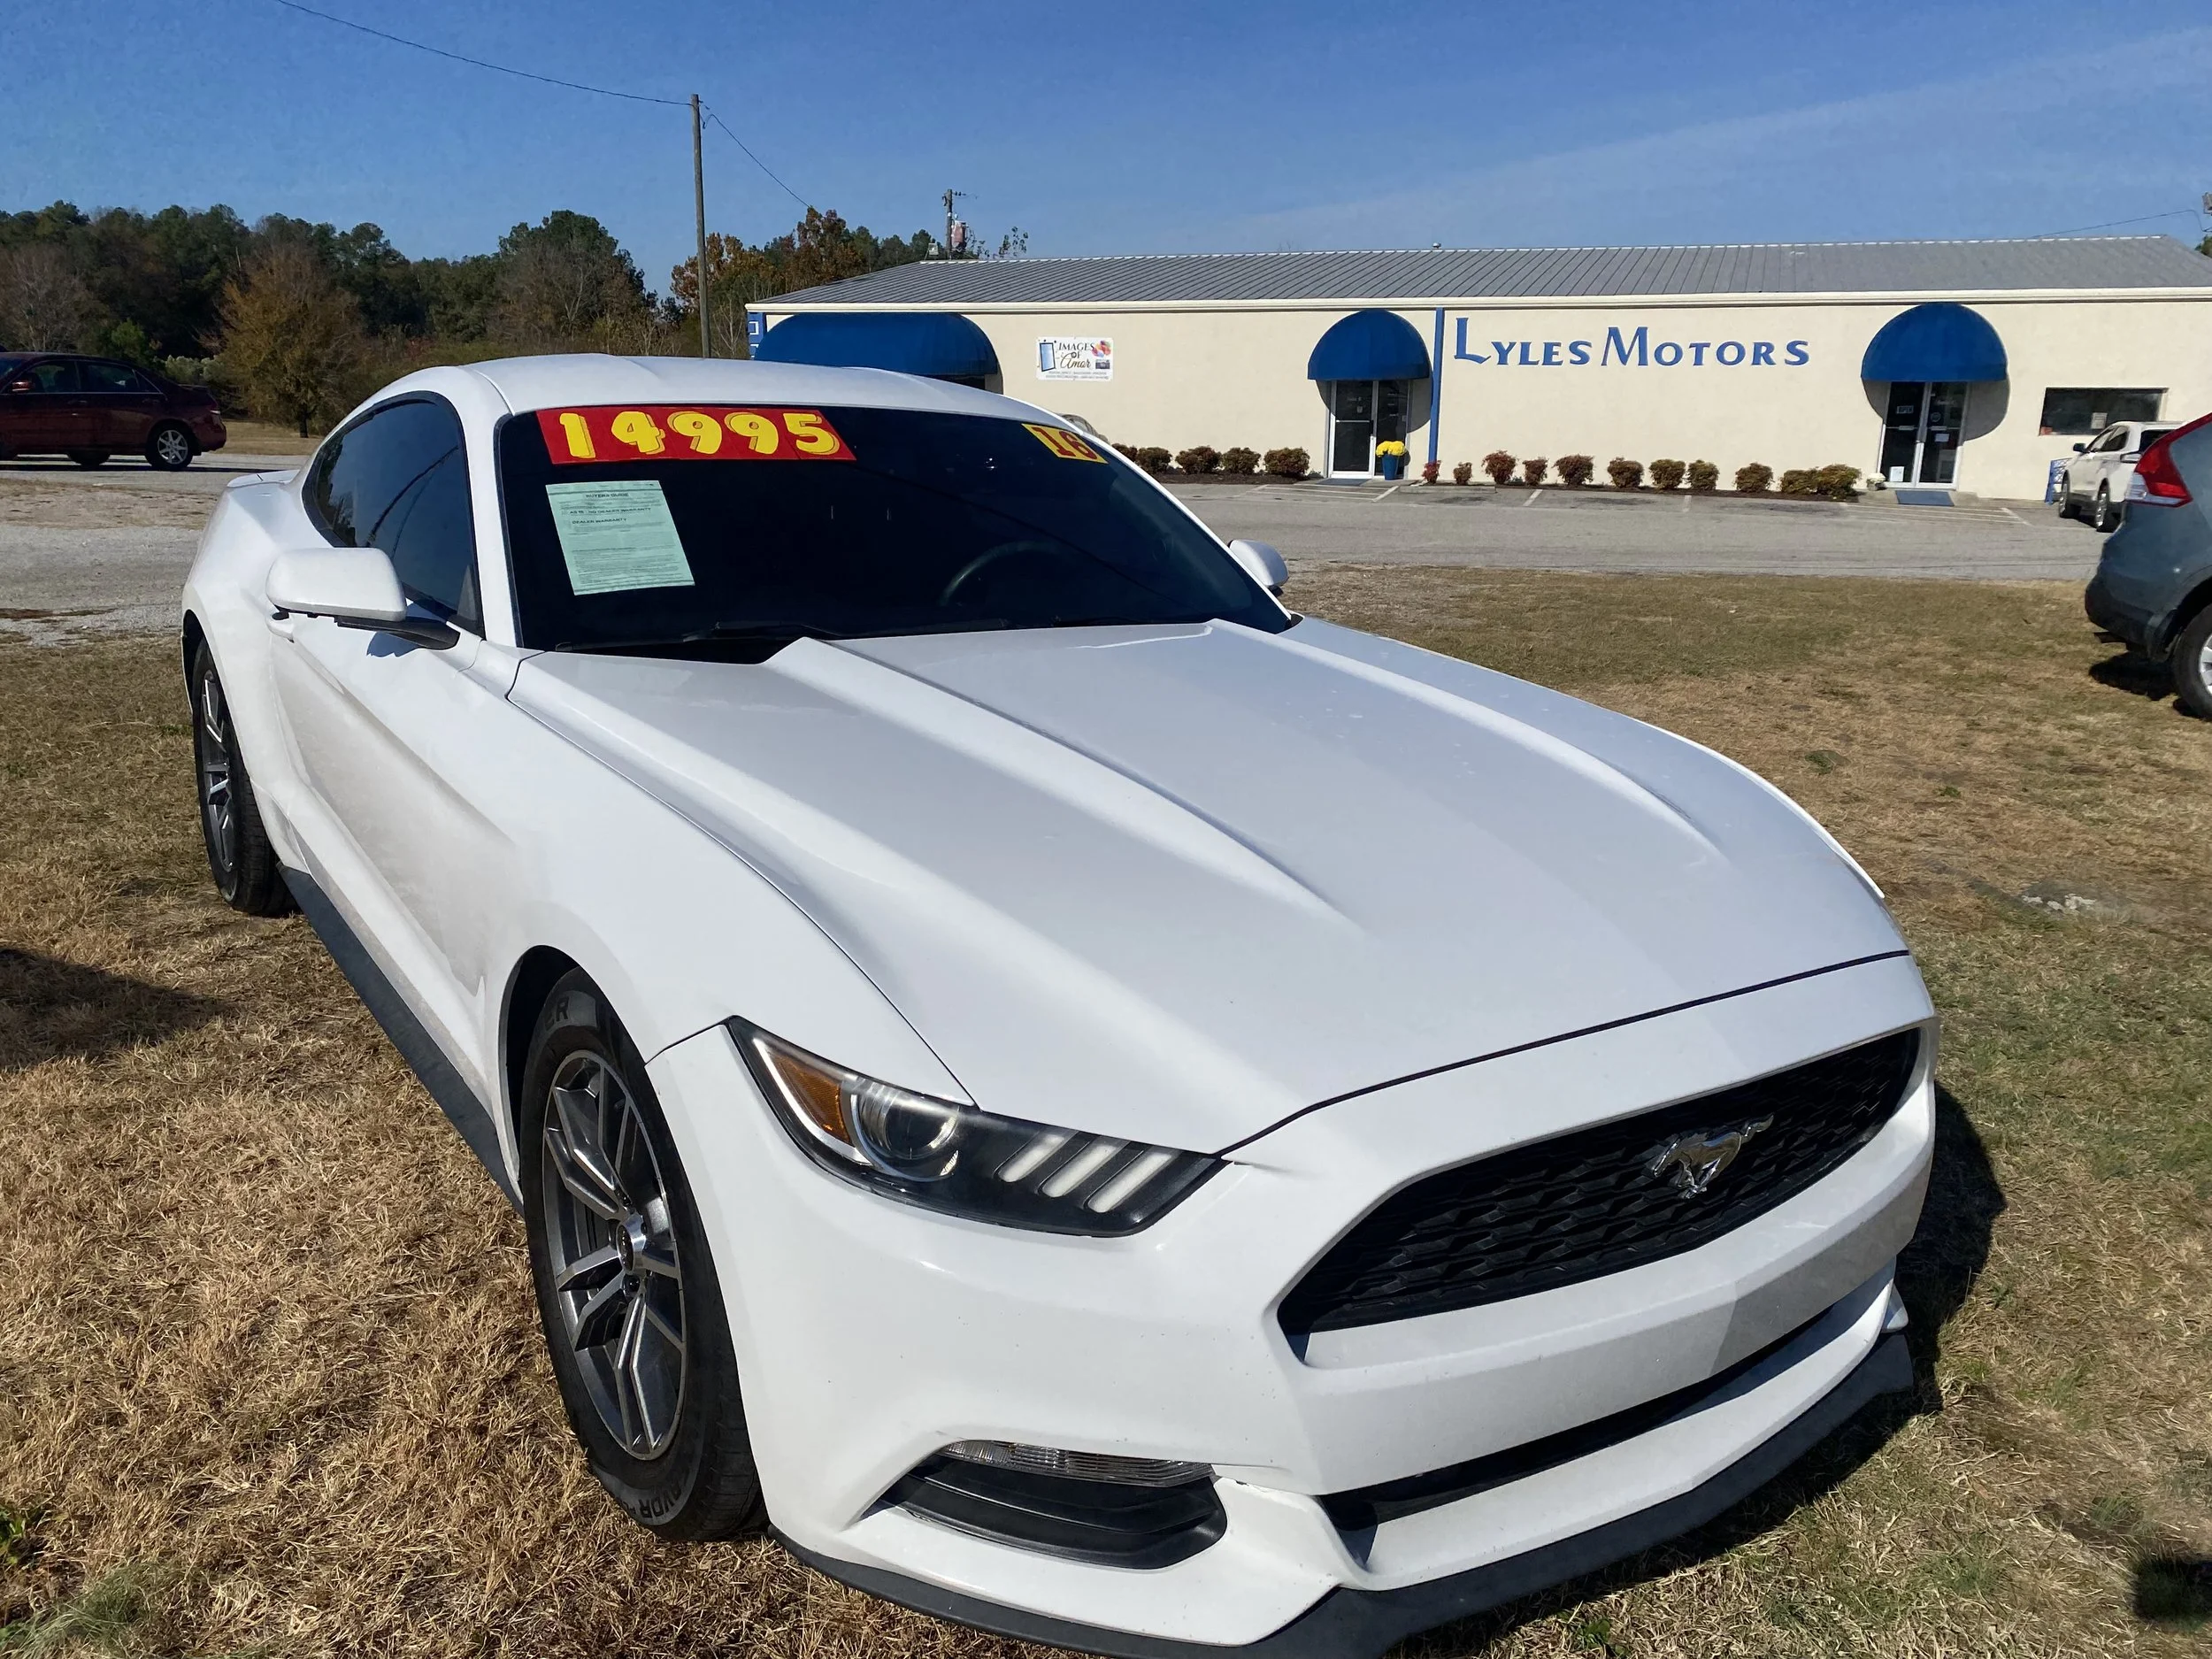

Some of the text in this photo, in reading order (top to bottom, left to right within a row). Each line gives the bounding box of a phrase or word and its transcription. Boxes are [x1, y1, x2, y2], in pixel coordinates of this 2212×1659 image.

[1058, 342, 1094, 351] IMAGES
[1453, 316, 1810, 367] LYLES MOTORS
[1060, 352, 1092, 369] Amor
[558, 410, 841, 459] 14995
[1031, 426, 1098, 460] 16
